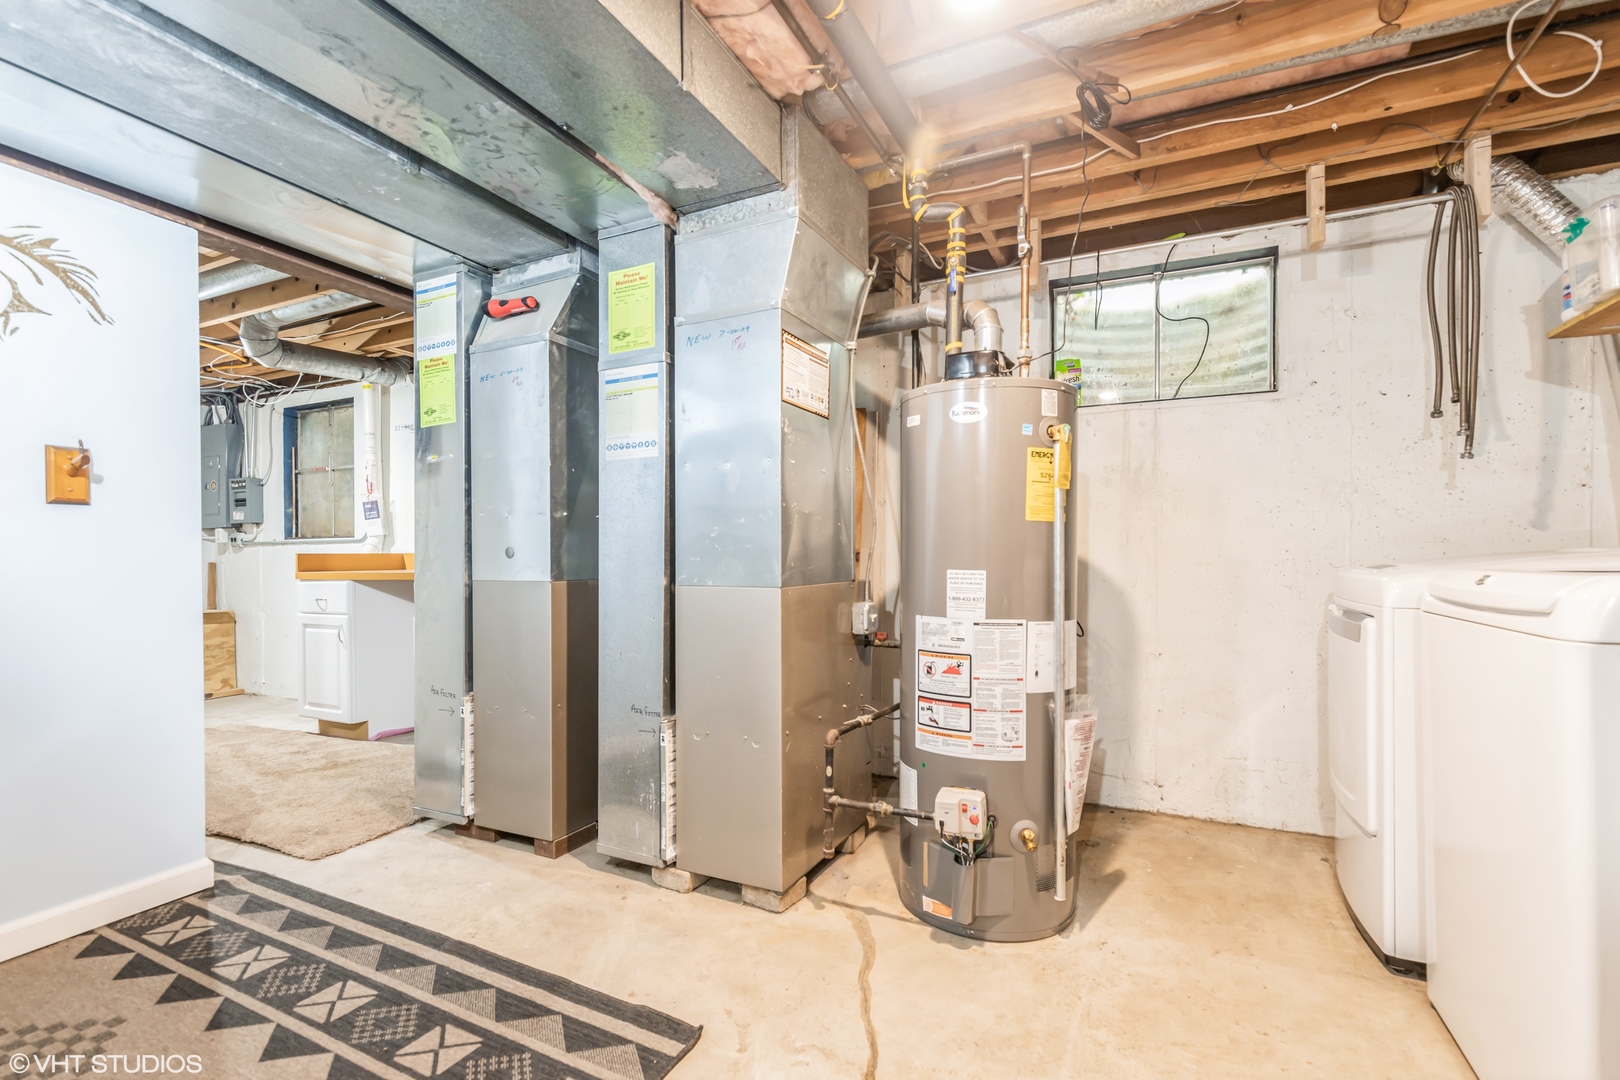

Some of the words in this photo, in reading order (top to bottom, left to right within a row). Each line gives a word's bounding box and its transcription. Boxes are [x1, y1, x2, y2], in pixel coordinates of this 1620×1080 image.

[616, 278, 638, 286] Maintain
[686, 333, 712, 347] NEW
[480, 374, 495, 383] NEW
[440, 688, 456, 699] FILTER
[631, 704, 643, 716] AIR
